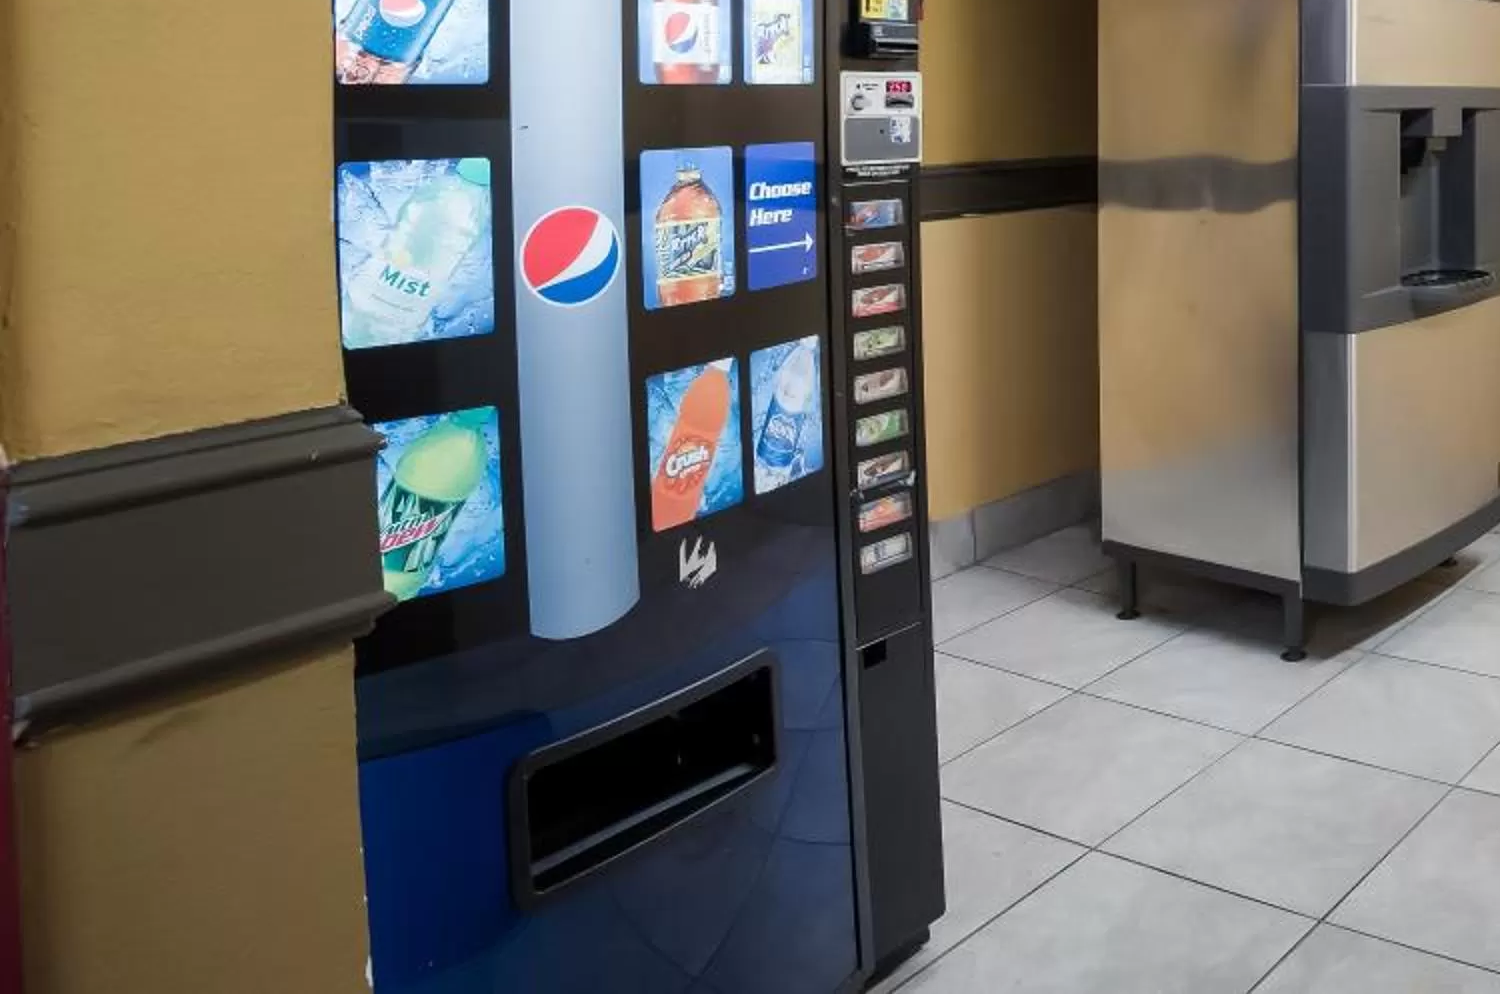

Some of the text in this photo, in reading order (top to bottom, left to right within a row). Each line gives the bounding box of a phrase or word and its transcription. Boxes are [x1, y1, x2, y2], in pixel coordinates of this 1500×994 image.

[749, 181, 812, 201] Choose
[749, 208, 793, 227] Here
[380, 265, 430, 297] Mist
[666, 446, 709, 477] Crush
